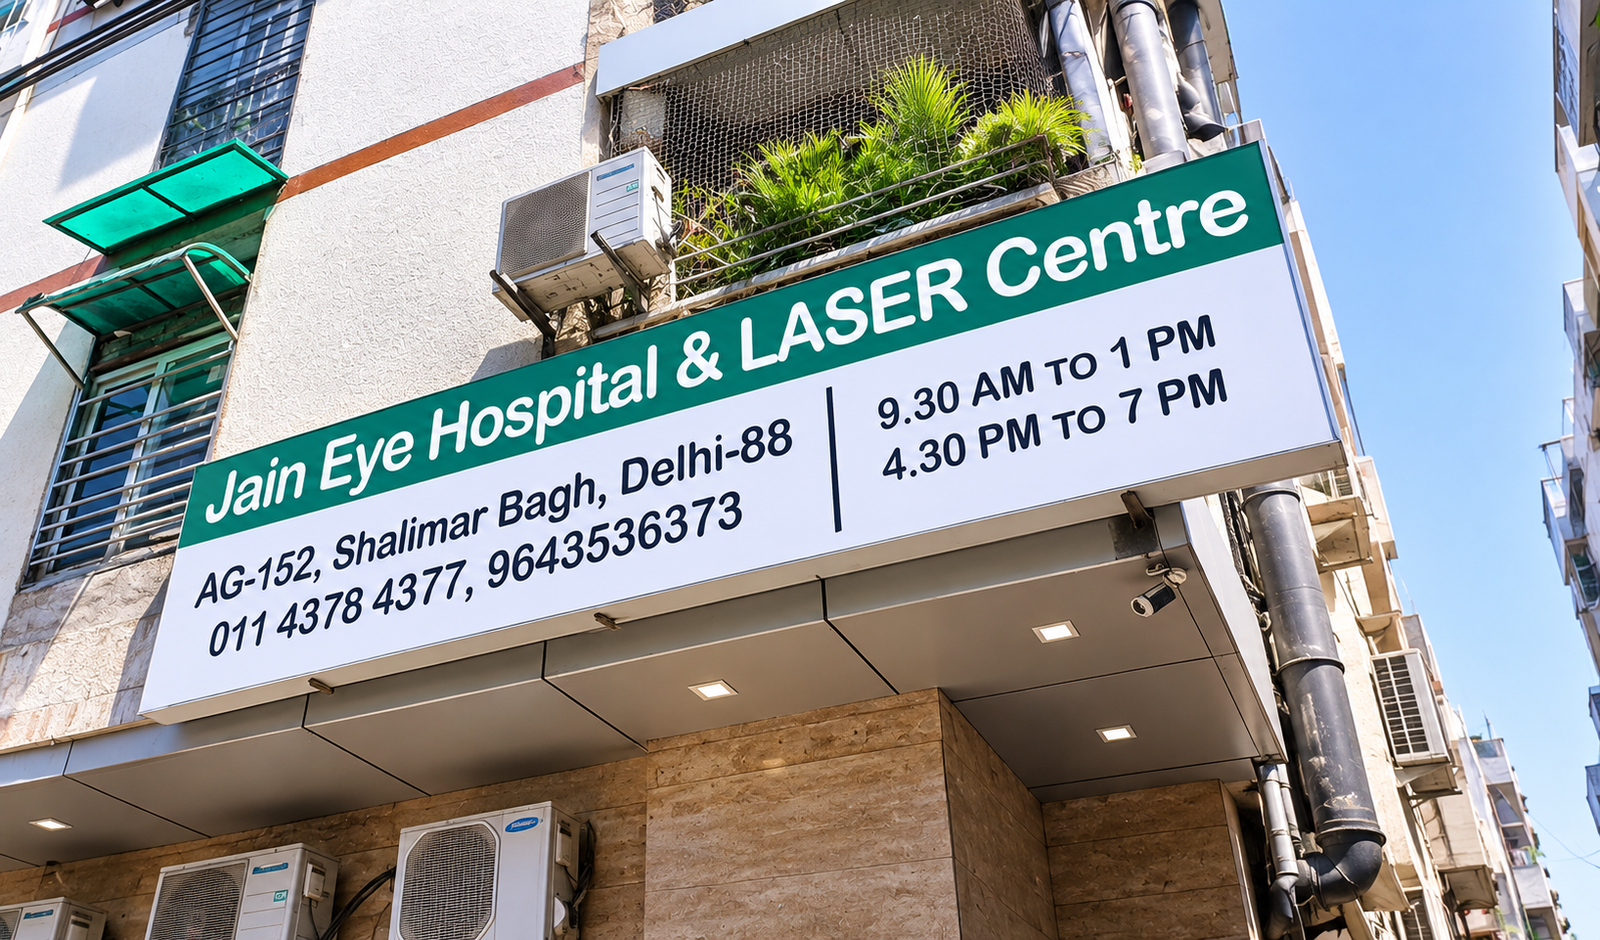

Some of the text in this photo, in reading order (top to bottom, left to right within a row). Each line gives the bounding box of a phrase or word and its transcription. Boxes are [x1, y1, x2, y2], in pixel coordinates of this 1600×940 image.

[204, 189, 1249, 524] Jain Eye Hospital & LASER Centre
[878, 314, 1216, 430] 9.30 AM TO 1 PM
[882, 368, 1228, 481] 4.30 PM TO 7 PM
[194, 418, 793, 609] AG-152, Shalimar Bagh, Delhi-88
[209, 491, 743, 657] 011 4378 4377, 9643536373
